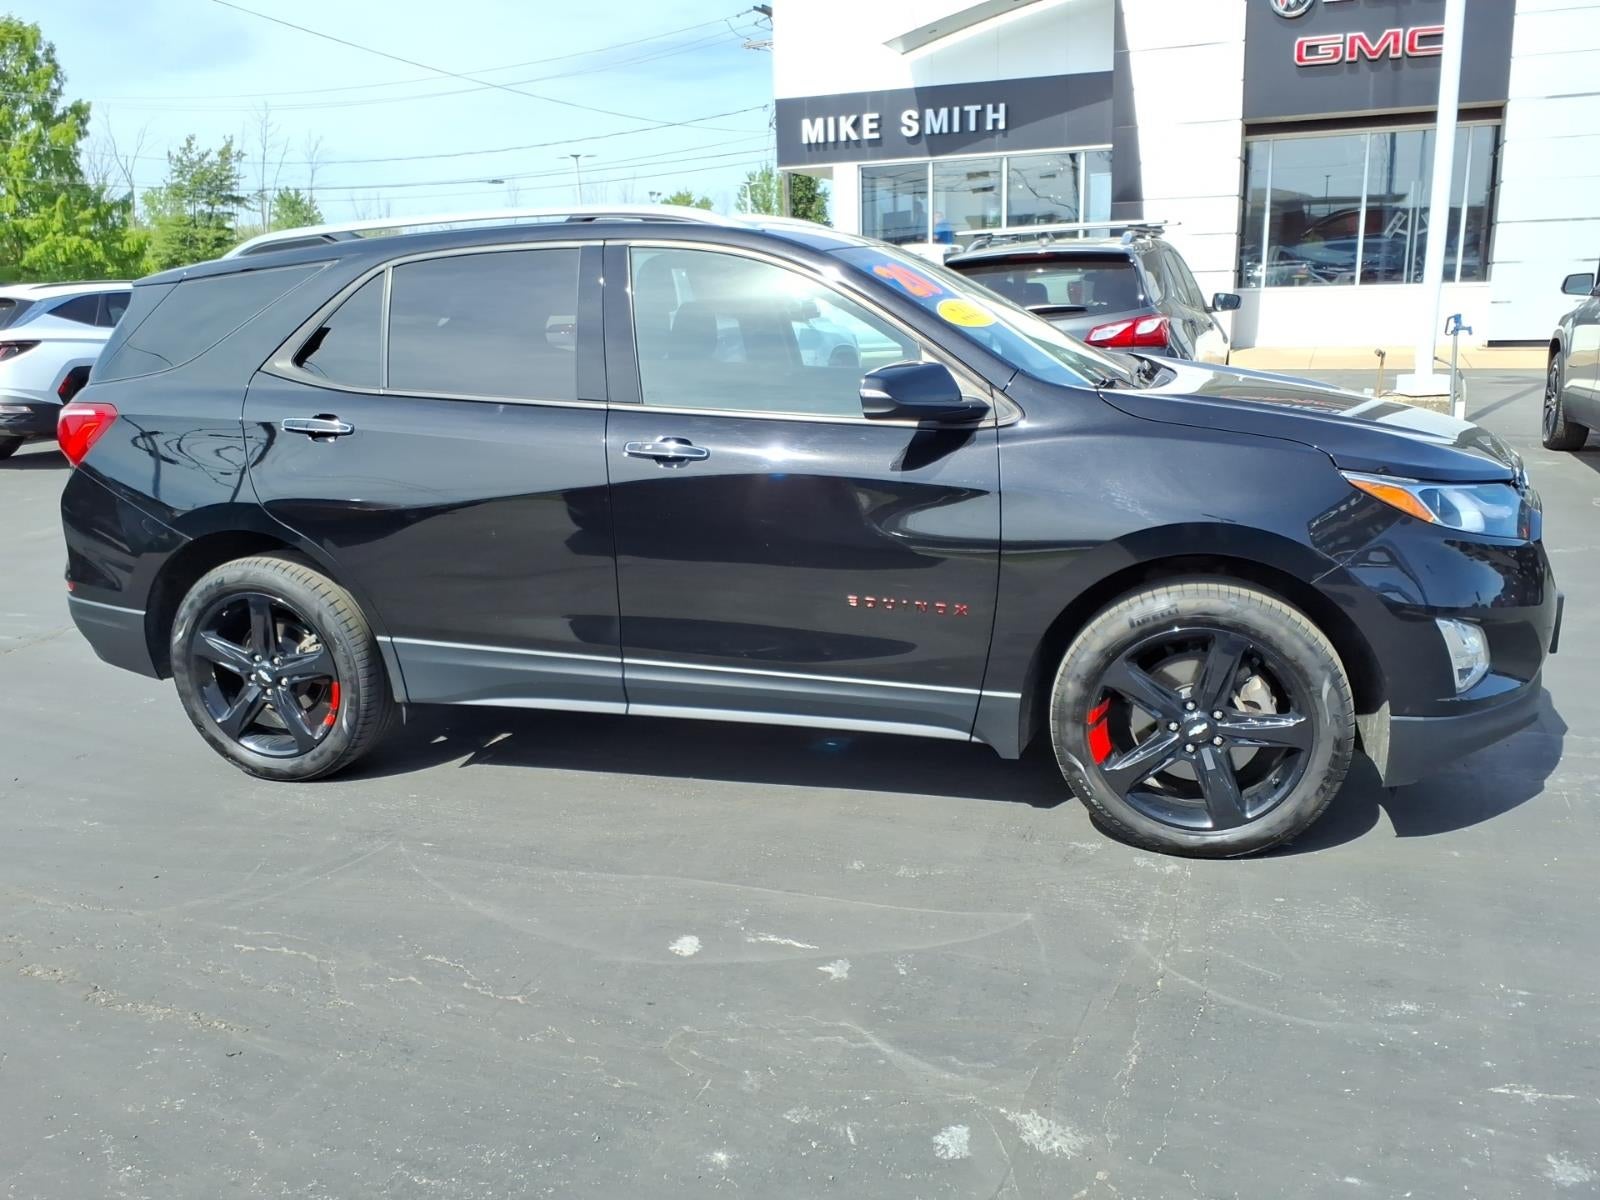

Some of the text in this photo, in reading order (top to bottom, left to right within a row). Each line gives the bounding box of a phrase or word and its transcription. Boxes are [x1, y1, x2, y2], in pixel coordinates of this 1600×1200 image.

[1294, 25, 1445, 67] GMC
[801, 102, 1006, 144] MIKE SMITH
[847, 595, 968, 616] EQUINOX
